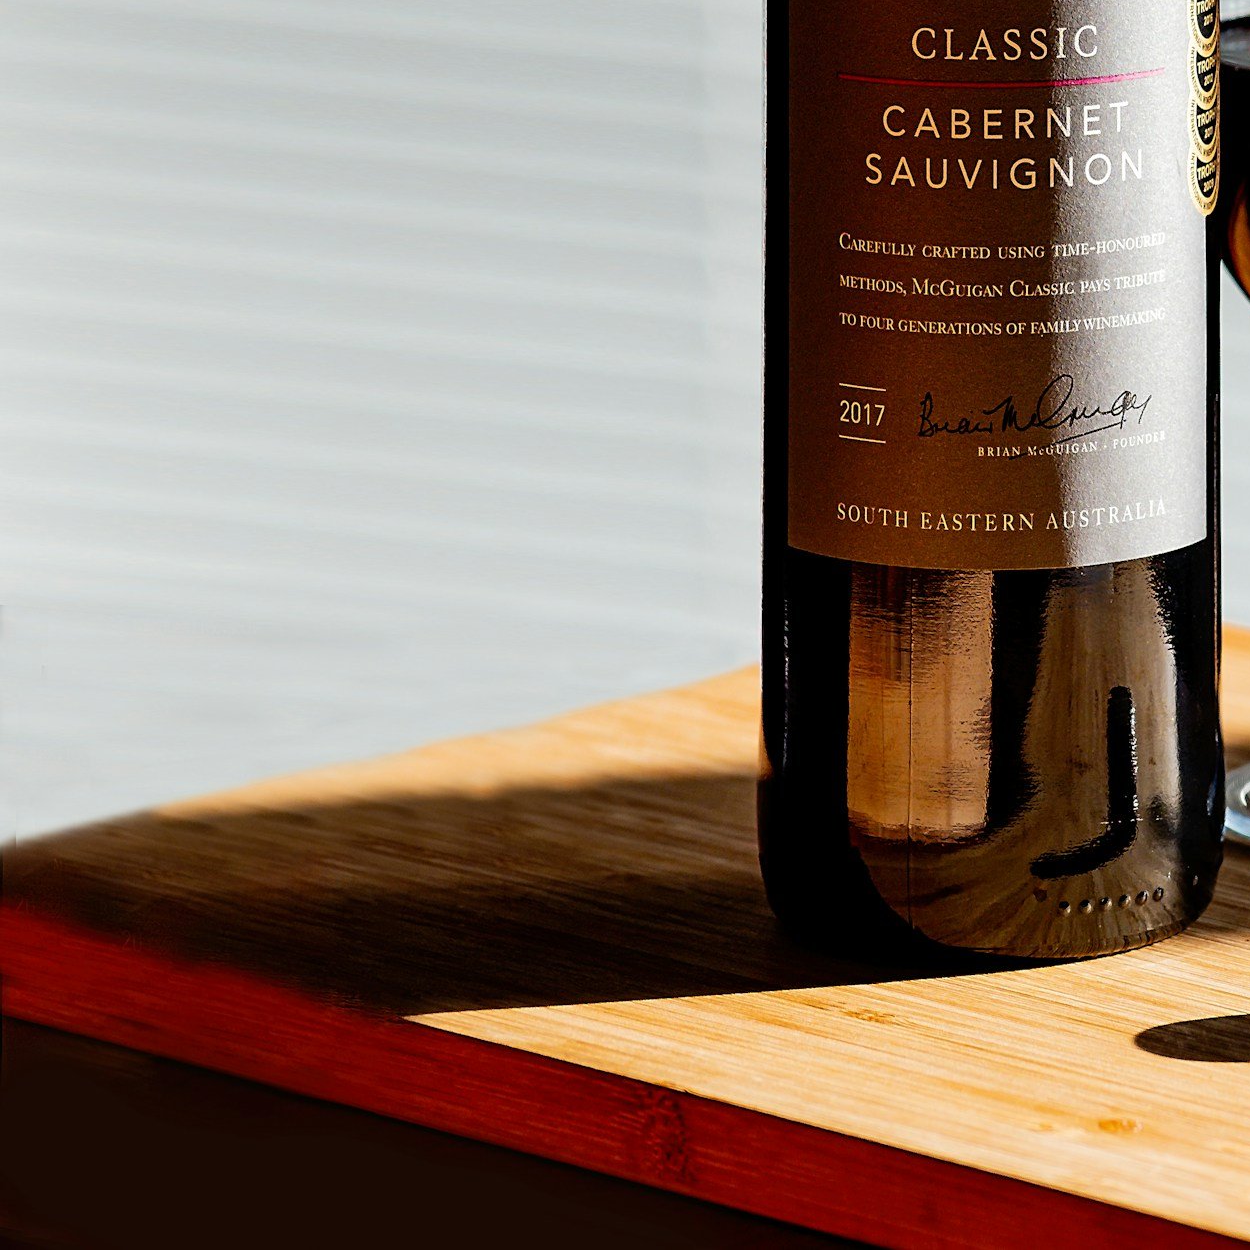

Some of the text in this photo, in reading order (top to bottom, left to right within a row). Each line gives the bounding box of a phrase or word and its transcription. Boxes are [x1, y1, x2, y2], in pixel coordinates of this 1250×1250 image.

[911, 25, 1098, 61] CLASSIC
[882, 101, 1129, 140] CABERNET
[865, 149, 1143, 190] SAUVIGNON
[839, 232, 1166, 260] CAREFULLY CRAFTED USING TIME-HONOURED
[839, 274, 907, 297] METHODS,
[1009, 280, 1075, 297] CLASSIC
[1080, 279, 1111, 293] PAYS
[1114, 269, 1166, 289] TRIBUTE
[839, 308, 1166, 336] TO FOUR GENERATIONS OF FAMILY WINEMAKING
[839, 400, 885, 427] 2017
[978, 446, 1021, 457] BRIAN
[1113, 430, 1166, 450] FOUNDER
[837, 498, 1166, 531] SOUTH EASTERN AUSTRALIA
